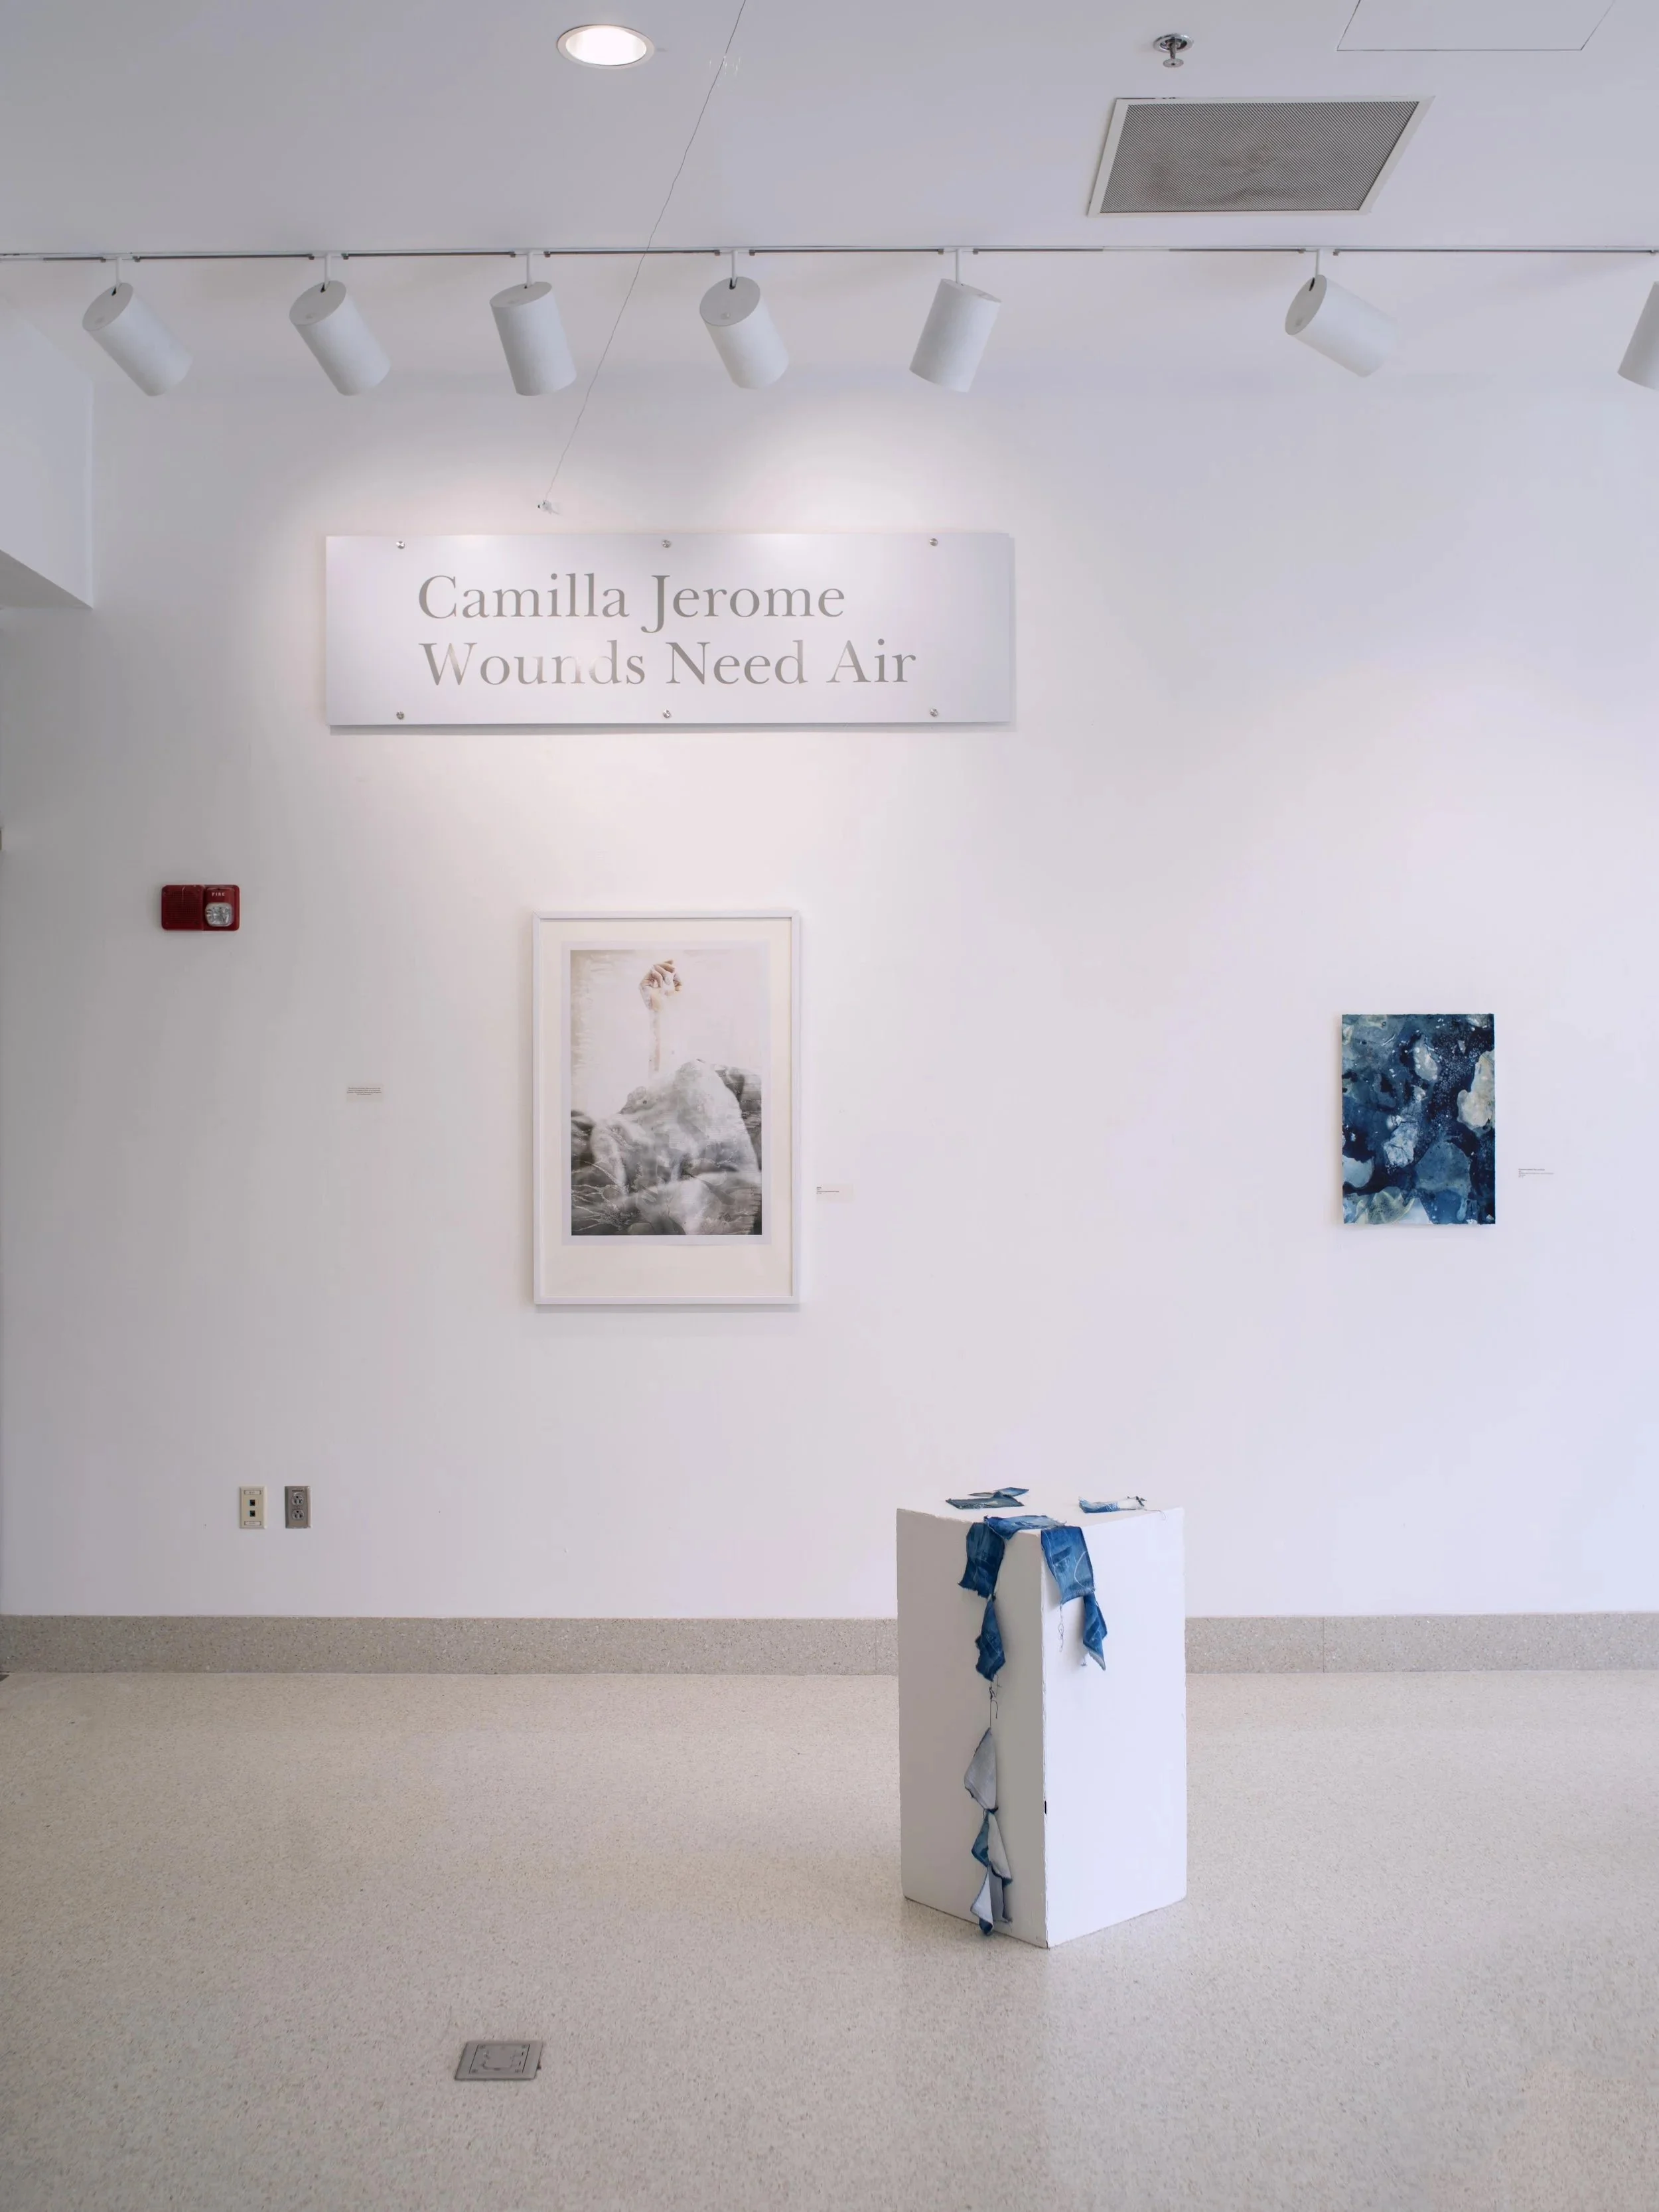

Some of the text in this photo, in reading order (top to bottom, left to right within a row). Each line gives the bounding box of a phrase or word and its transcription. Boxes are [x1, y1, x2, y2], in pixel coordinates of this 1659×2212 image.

[419, 573, 844, 633] Camilla Jerome
[419, 638, 916, 686] Wounds Need Air
